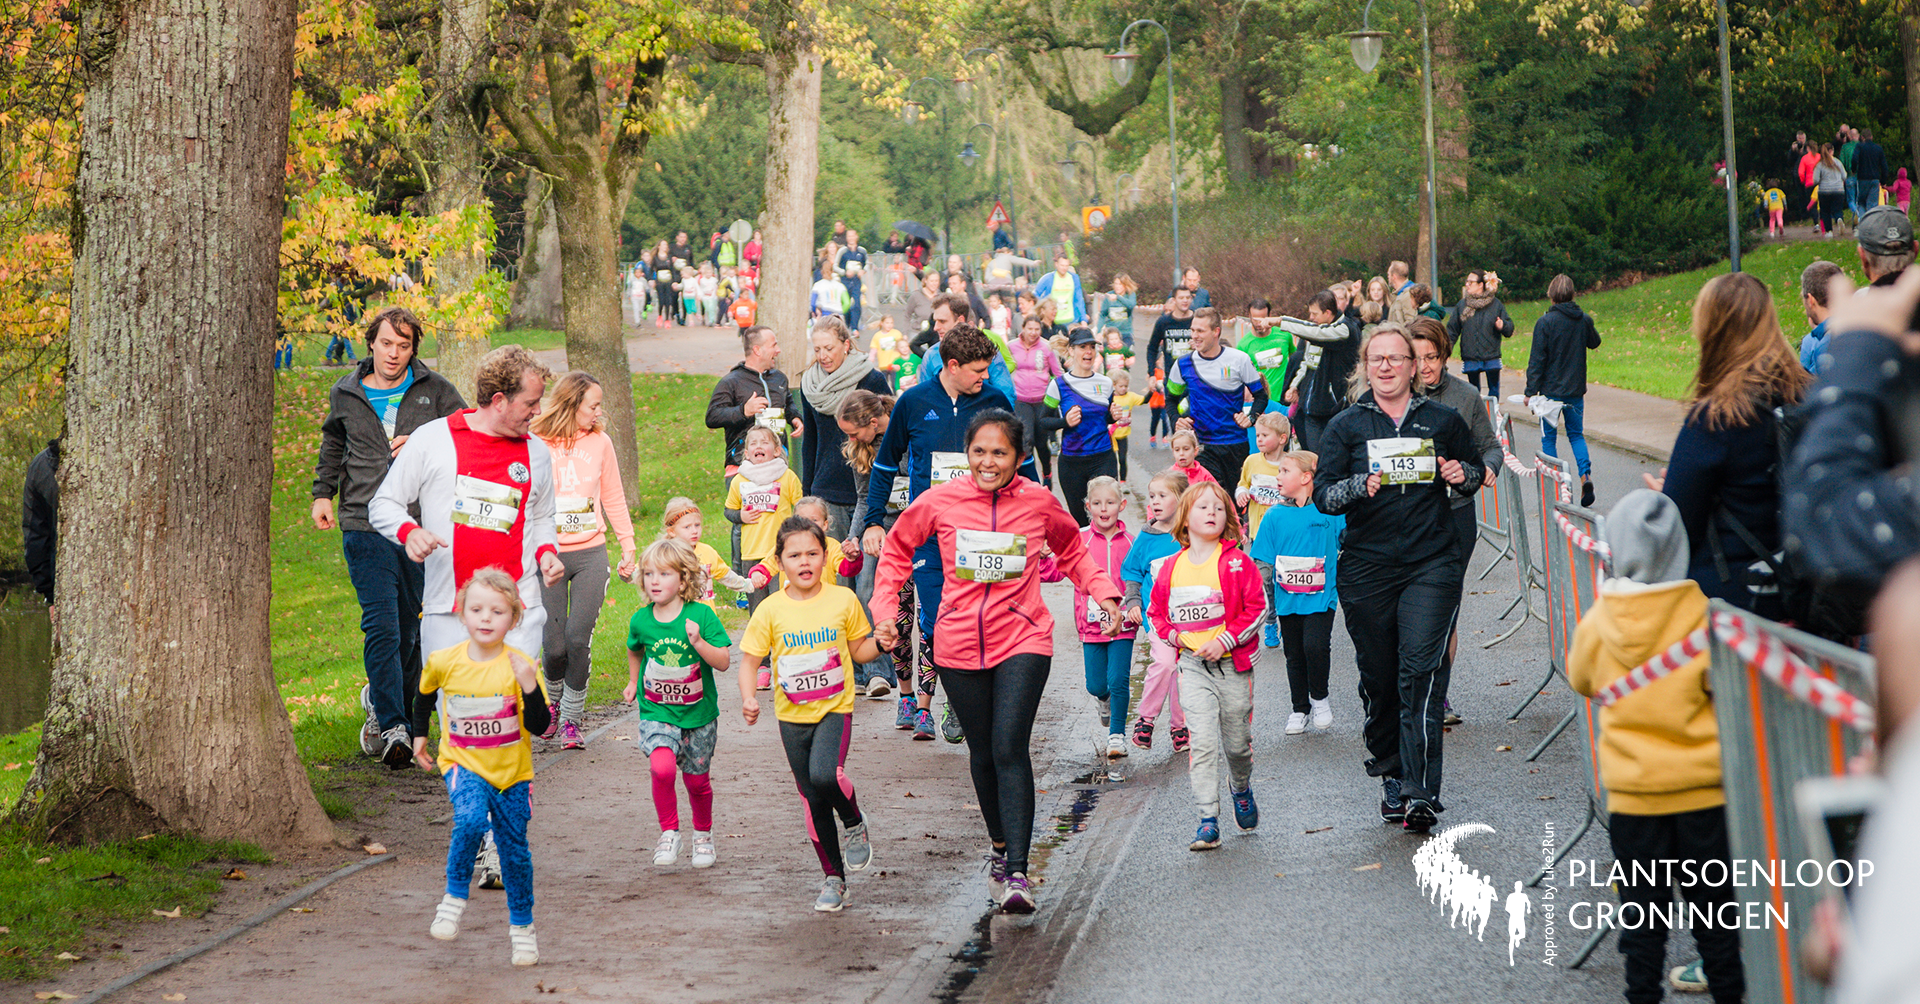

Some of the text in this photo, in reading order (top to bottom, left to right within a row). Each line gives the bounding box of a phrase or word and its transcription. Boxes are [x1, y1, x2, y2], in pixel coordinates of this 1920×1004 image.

[551, 447, 593, 465] ALIFORNIA
[1391, 457, 1416, 471] 143
[1389, 471, 1420, 481] COACH
[748, 494, 771, 504] 2090
[1258, 487, 1280, 498] 2262
[479, 502, 493, 516] 19
[468, 514, 499, 527] COACH
[565, 513, 580, 525] 36
[560, 523, 583, 532] COACH
[978, 555, 1004, 570] 138
[973, 569, 1006, 580] COACH
[1286, 573, 1314, 585] 2140
[1178, 606, 1210, 622] 2182
[651, 637, 689, 652] BORGMAN
[782, 626, 838, 650] Chiquita
[654, 682, 691, 695] 2056
[794, 673, 829, 691] 2175
[662, 694, 684, 703] ELLA
[463, 720, 502, 736] 2180
